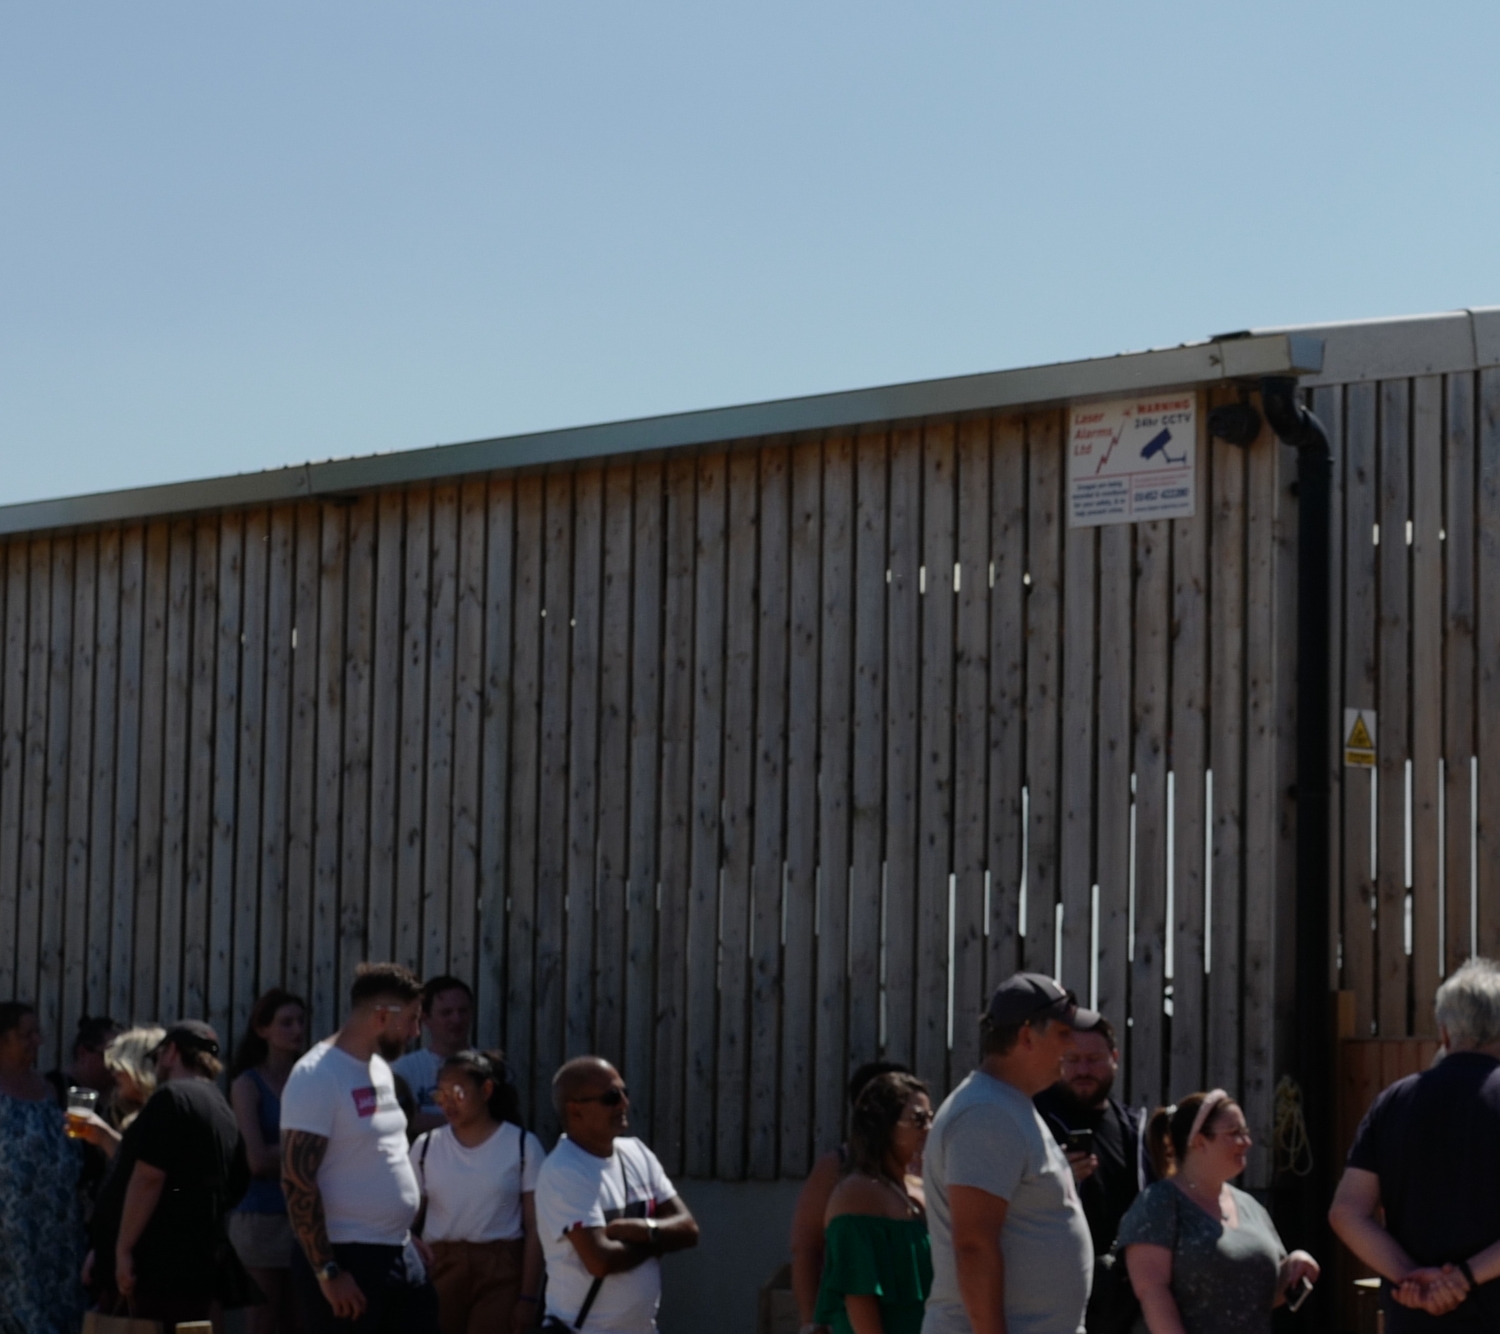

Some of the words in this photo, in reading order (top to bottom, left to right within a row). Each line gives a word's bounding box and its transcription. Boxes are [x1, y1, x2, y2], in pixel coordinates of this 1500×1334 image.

[1137, 399, 1190, 414] WARNING
[1075, 413, 1104, 425] Laser
[1162, 413, 1192, 425] CCTV
[1075, 427, 1113, 439] Alarms
[1074, 444, 1093, 456] Ltd
